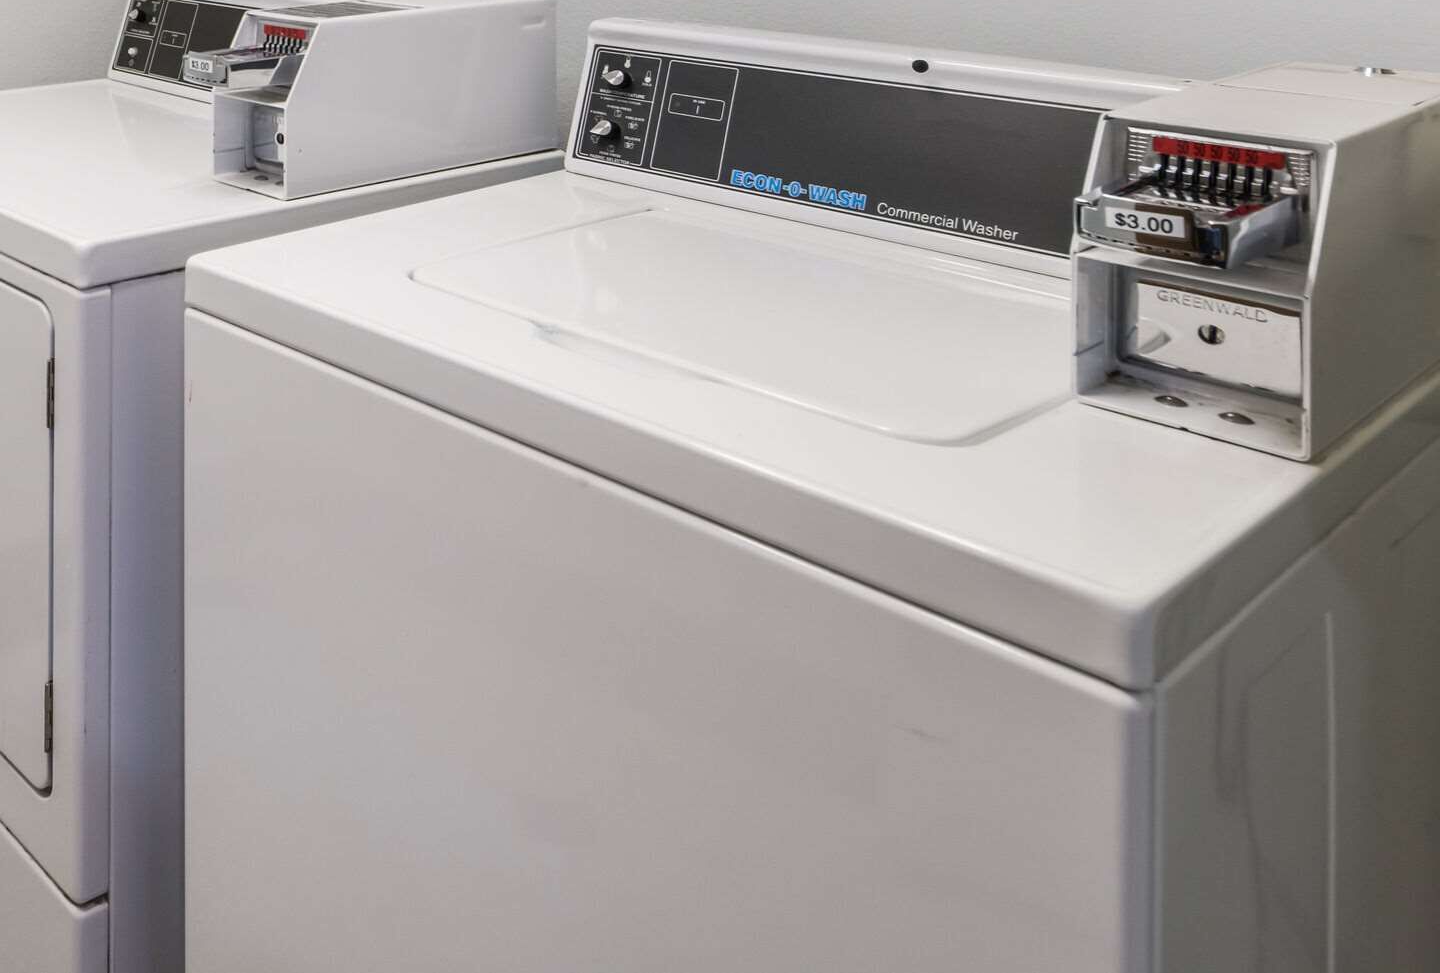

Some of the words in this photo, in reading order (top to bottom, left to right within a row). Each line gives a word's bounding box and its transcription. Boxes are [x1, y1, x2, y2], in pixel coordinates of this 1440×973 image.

[876, 202, 959, 229] Commercial
[962, 218, 1019, 241] Washer
[1114, 212, 1174, 234] $3.00
[1156, 289, 1268, 323] GREENWALD
